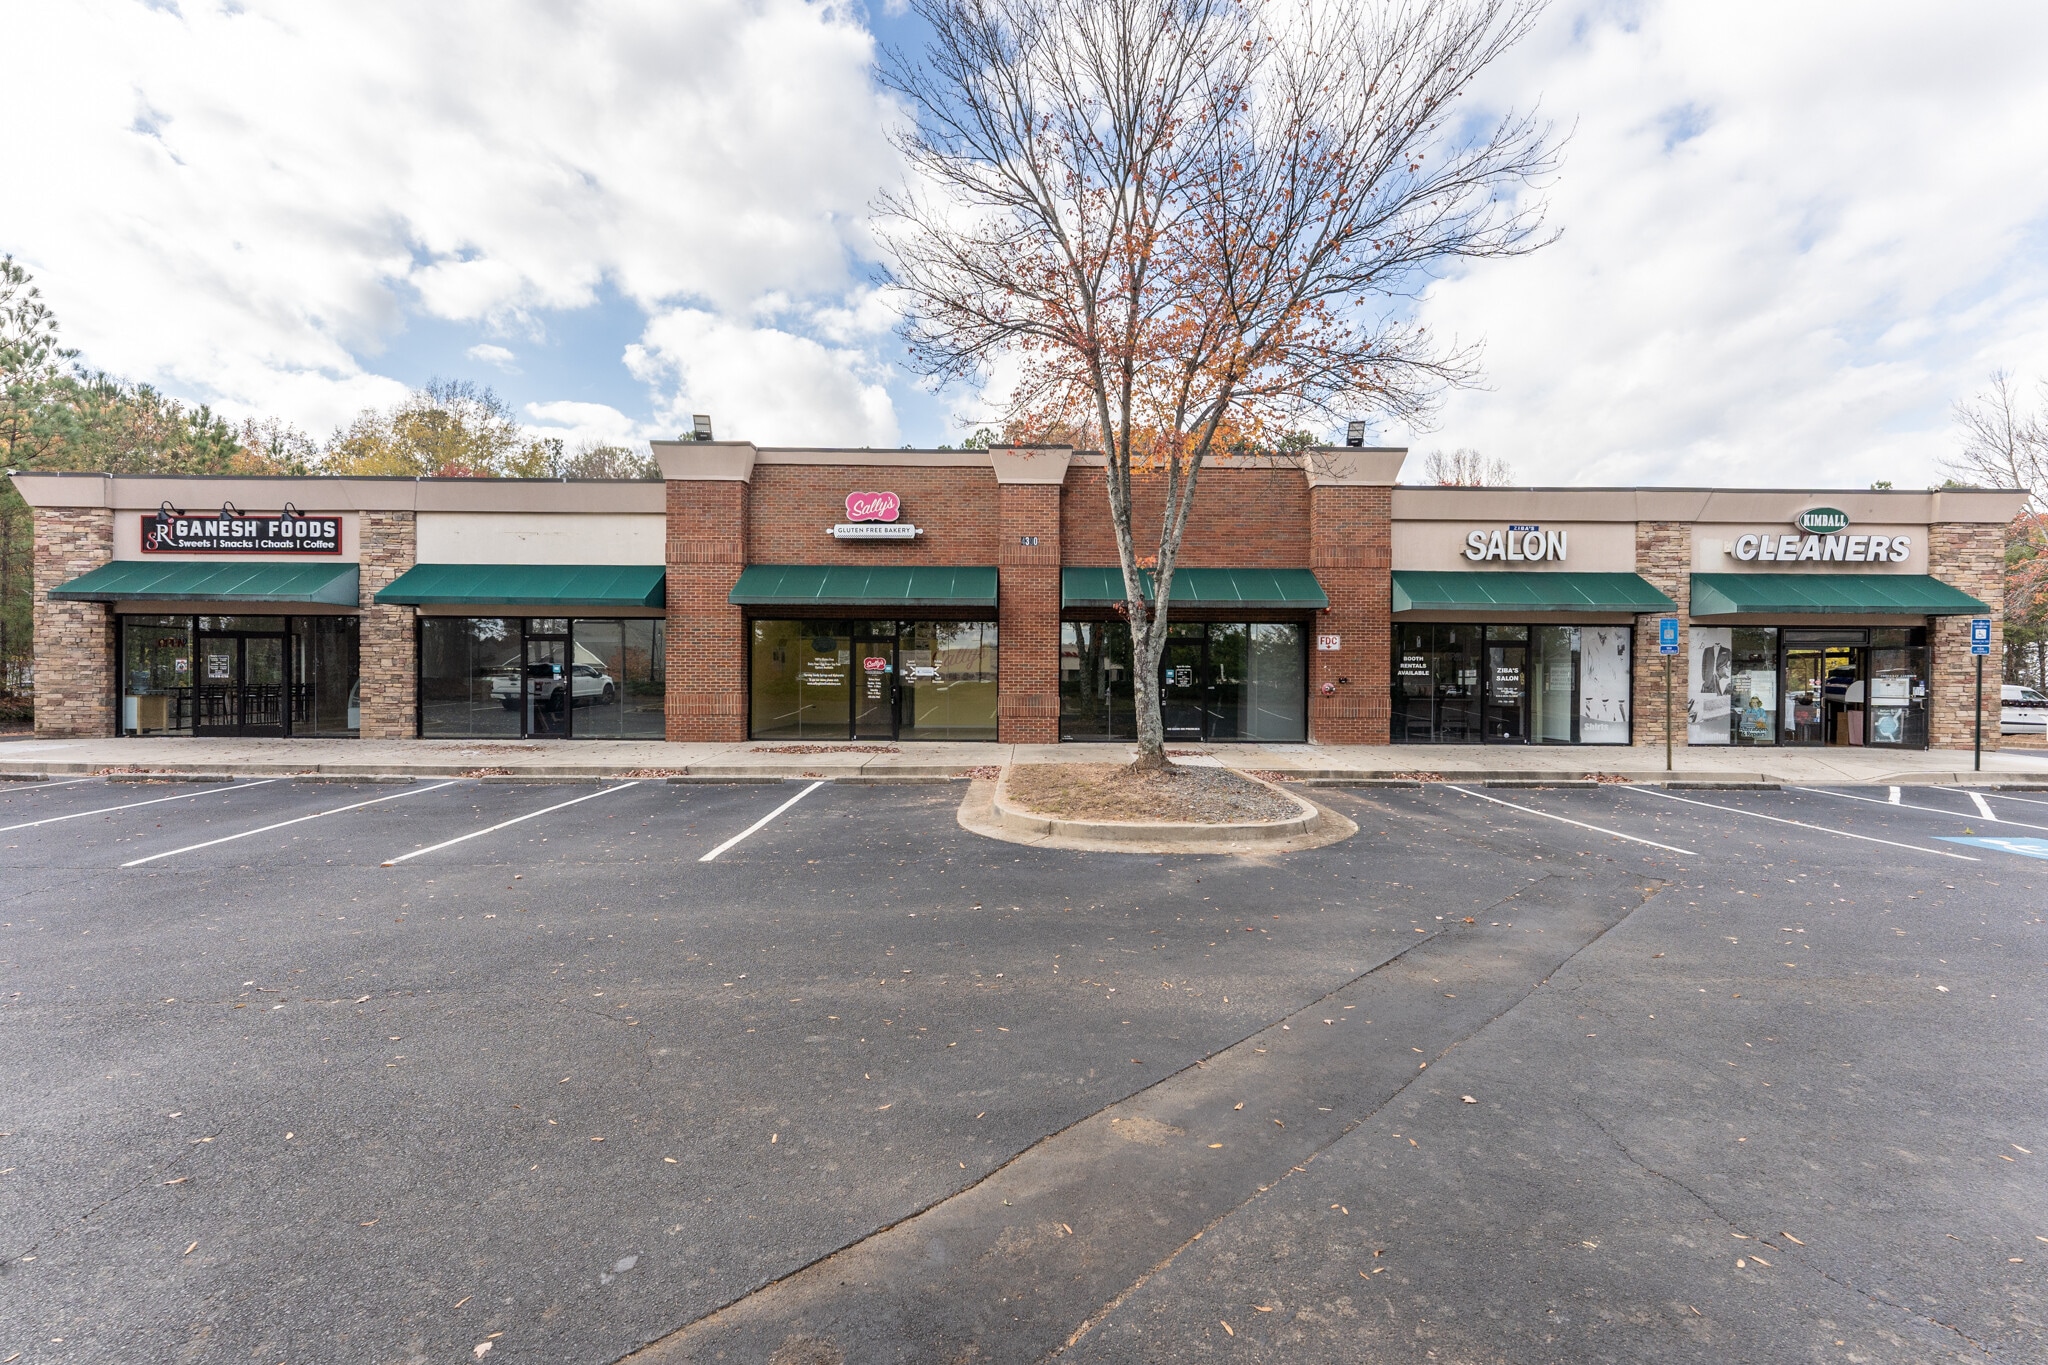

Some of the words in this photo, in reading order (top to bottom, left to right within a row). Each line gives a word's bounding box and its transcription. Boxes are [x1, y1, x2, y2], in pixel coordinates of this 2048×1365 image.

[852, 497, 895, 517] Sally's
[1803, 514, 1846, 527] KIMBALL
[176, 520, 257, 537] GANESH
[268, 521, 336, 538] FOODS
[178, 540, 211, 548] Sweets
[219, 540, 253, 549] Snacks
[303, 540, 335, 549] Coffee
[1465, 530, 1568, 561] SALON
[1734, 534, 1911, 562] CLEANERS
[1320, 636, 1338, 645] FDC
[1584, 723, 1609, 731] Shirts
